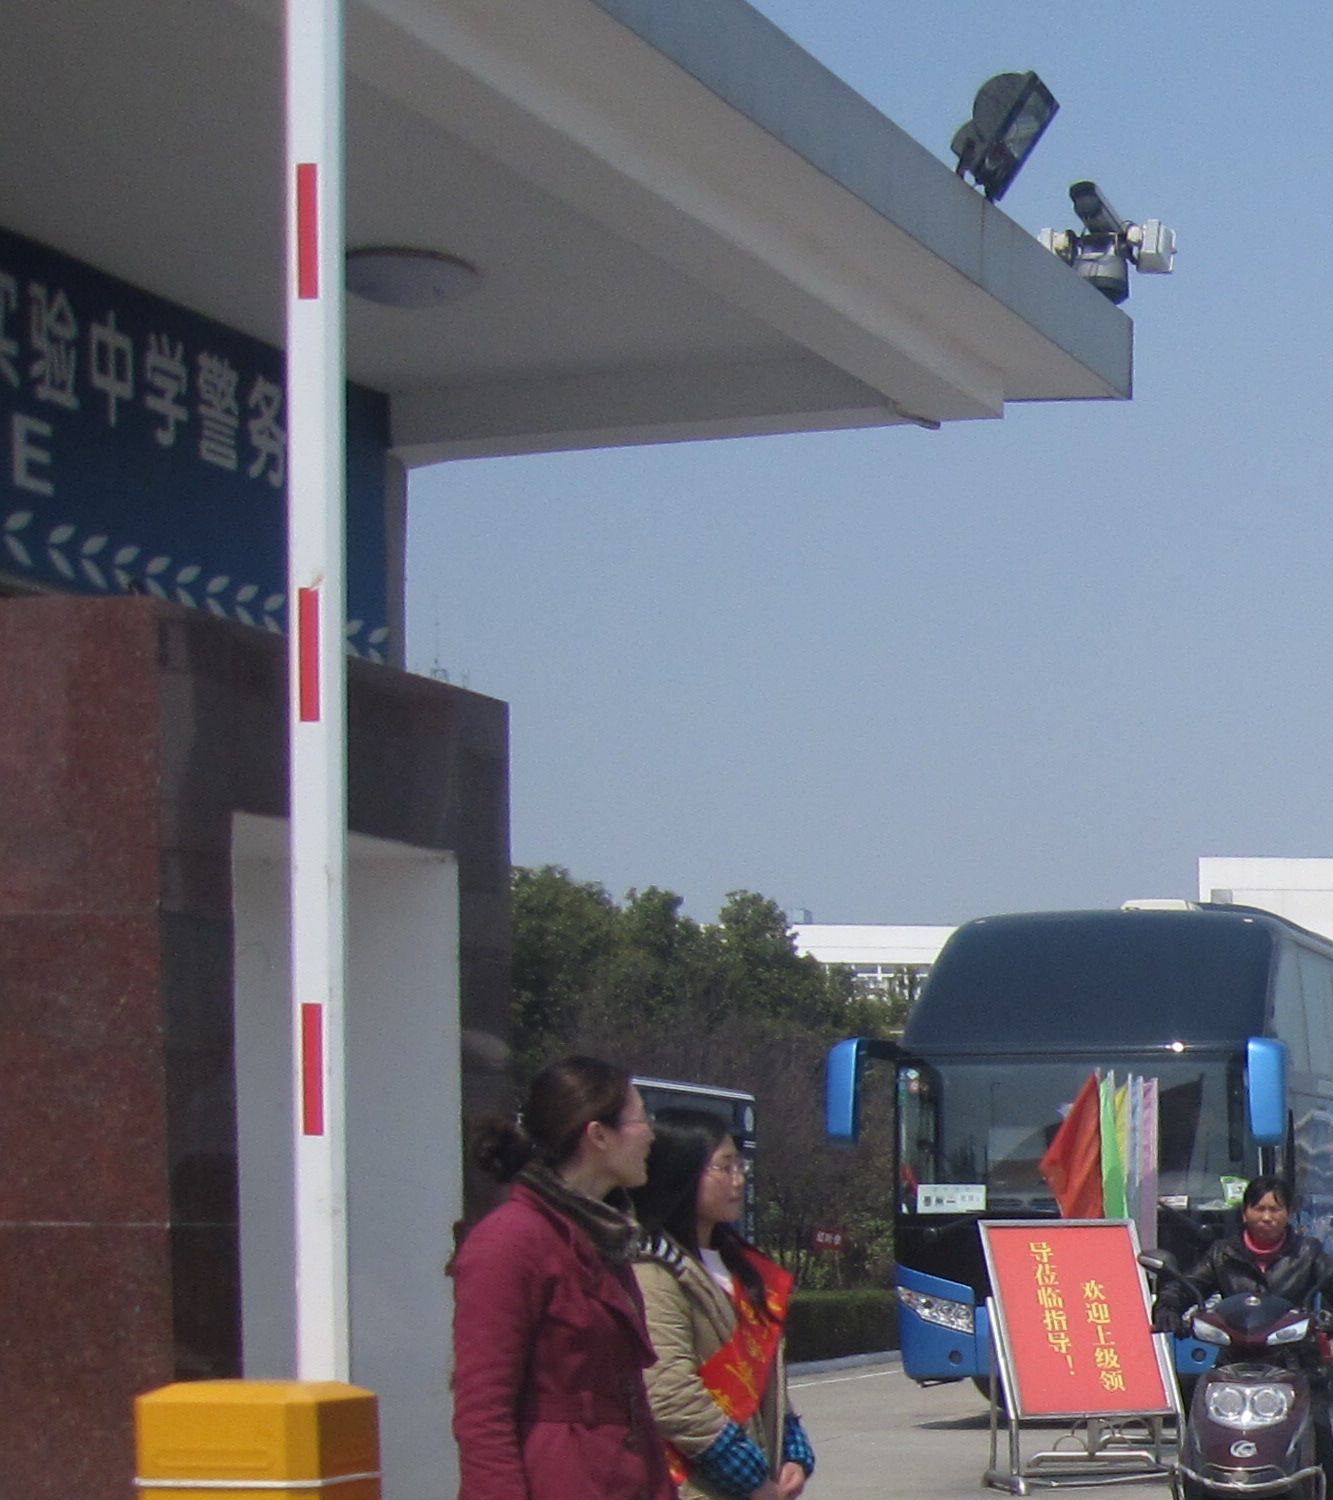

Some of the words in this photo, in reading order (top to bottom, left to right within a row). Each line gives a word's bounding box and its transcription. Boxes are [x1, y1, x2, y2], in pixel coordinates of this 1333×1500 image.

[1082, 1279, 1127, 1392] 欢迎上级领
